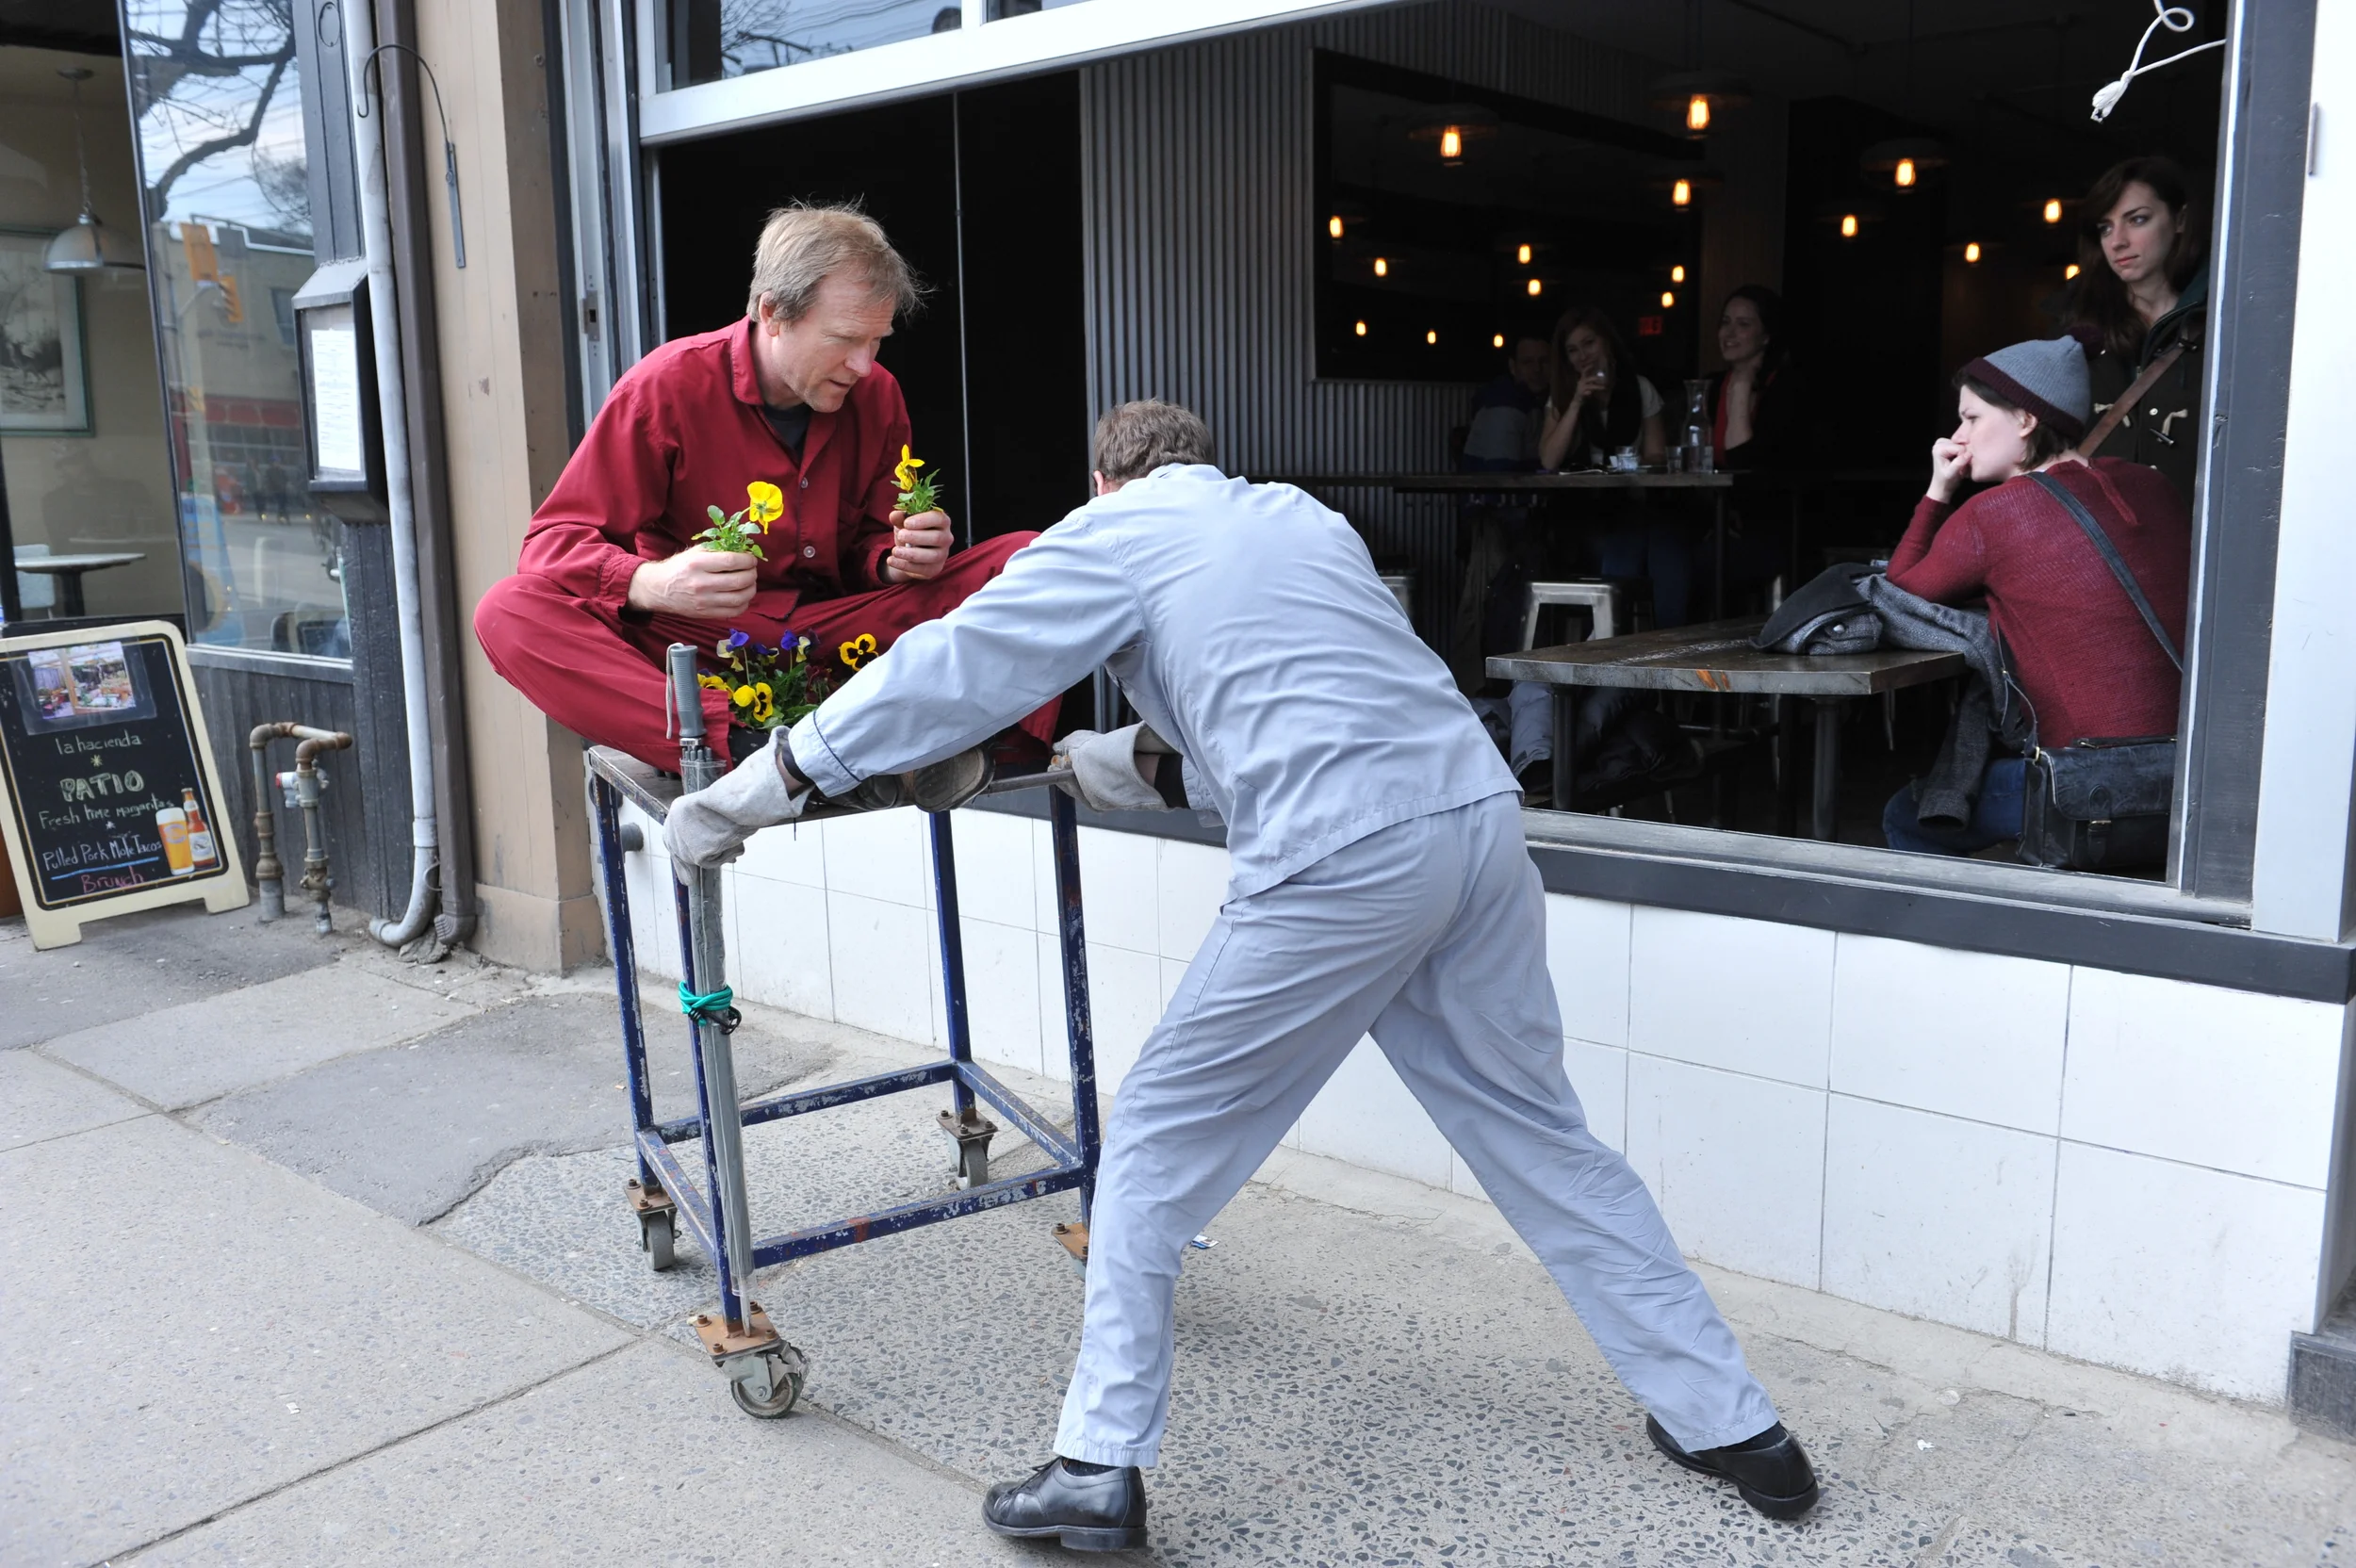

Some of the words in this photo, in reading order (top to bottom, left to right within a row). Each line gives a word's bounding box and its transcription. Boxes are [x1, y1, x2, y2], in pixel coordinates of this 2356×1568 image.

[75, 729, 142, 752] hacienda
[59, 770, 145, 802] PATIO
[39, 806, 81, 829] Fresh
[42, 846, 79, 871] Pulled
[80, 842, 110, 864] Pork
[81, 865, 144, 893] Brunch
